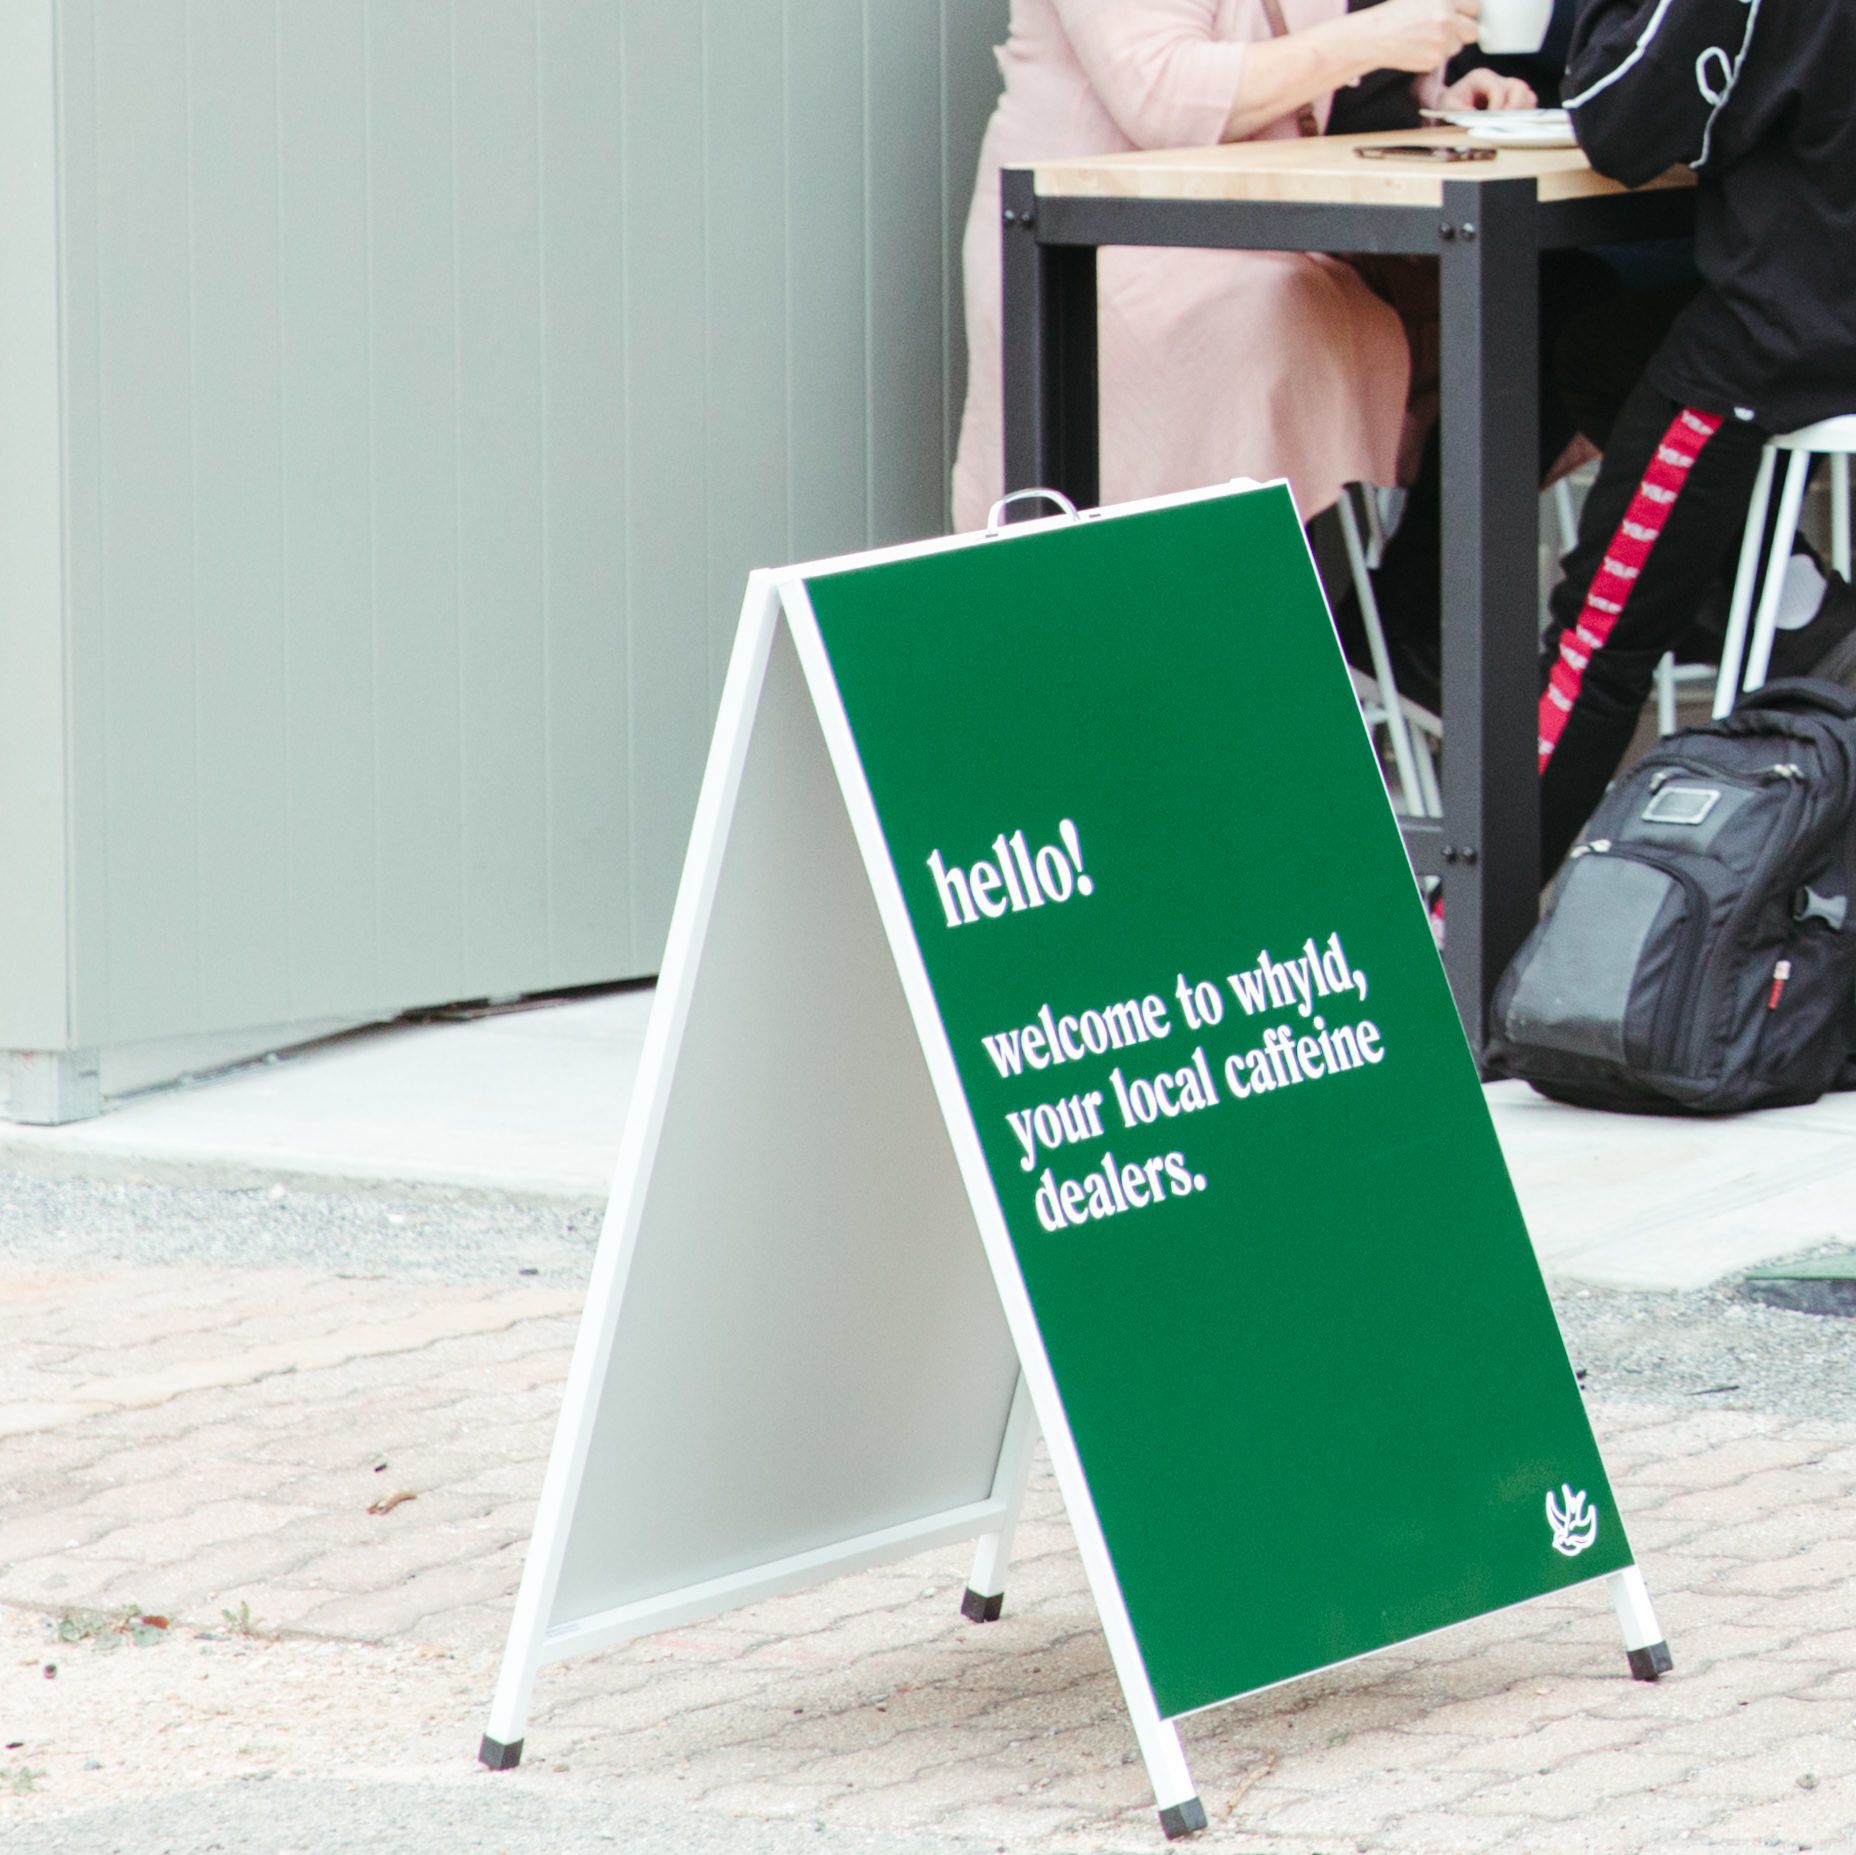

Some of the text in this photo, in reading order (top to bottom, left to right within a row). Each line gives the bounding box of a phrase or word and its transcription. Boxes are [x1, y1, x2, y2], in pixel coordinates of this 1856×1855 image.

[926, 818, 1093, 928] hello!
[981, 930, 1368, 1078] welcome to whyld,
[1006, 1016, 1386, 1172] your local caffeine
[1033, 1149, 1208, 1233] dealers.
